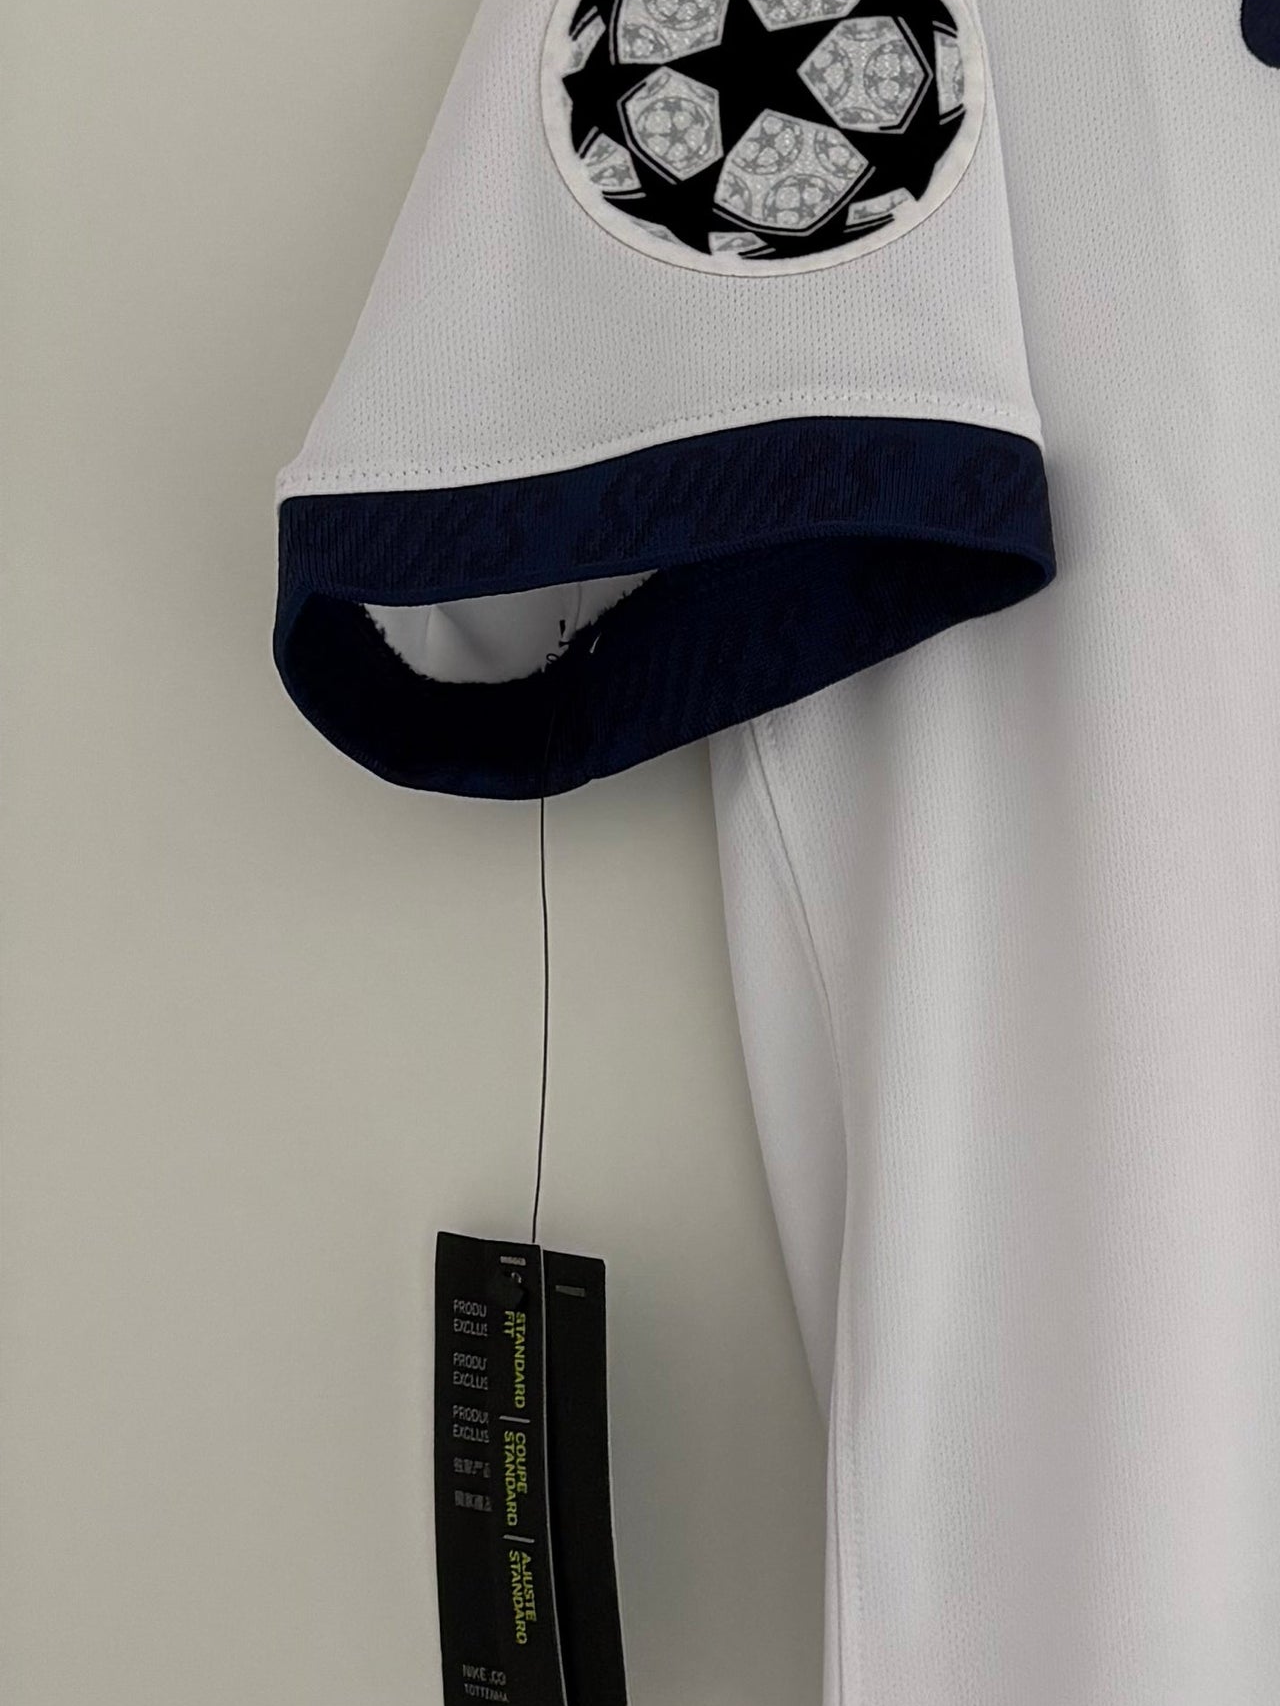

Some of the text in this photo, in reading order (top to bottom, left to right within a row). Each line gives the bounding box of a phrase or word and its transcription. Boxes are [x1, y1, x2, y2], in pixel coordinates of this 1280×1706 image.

[503, 1310, 515, 1338] FIT
[515, 1312, 526, 1409] STANDARD
[504, 1430, 518, 1526] STANDARD
[515, 1432, 528, 1494] COUPE
[509, 1549, 528, 1645] STANDARD
[521, 1551, 537, 1622] AJUSTE
